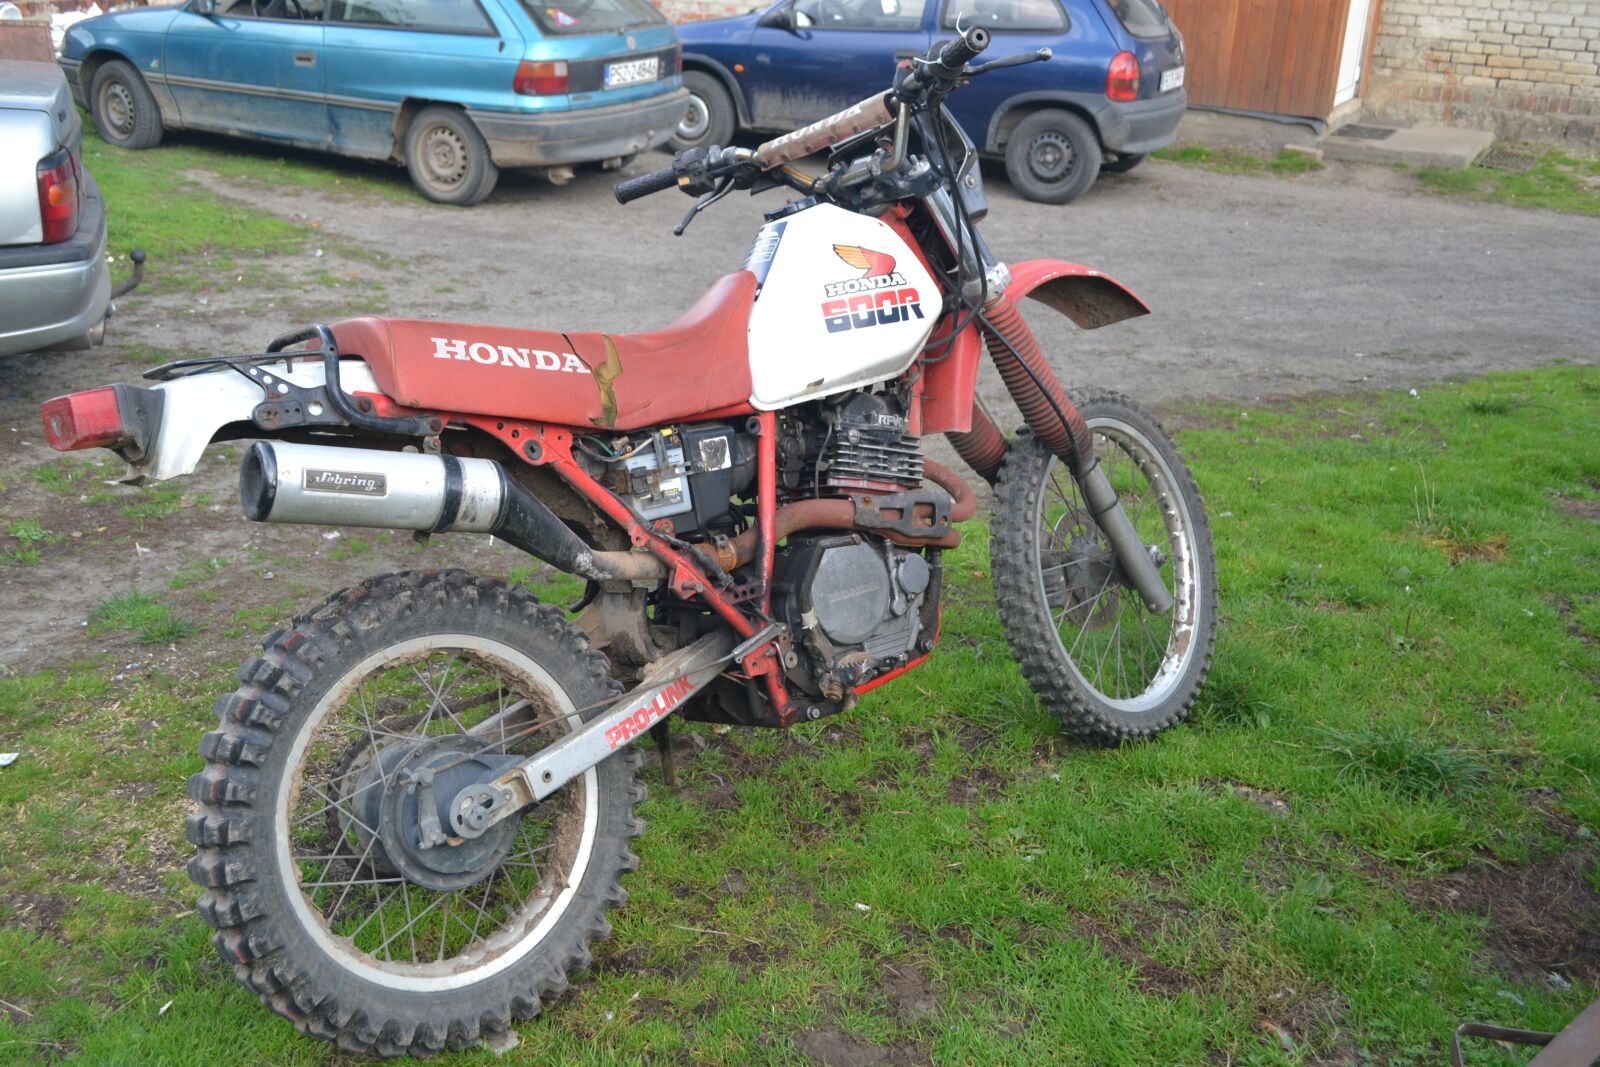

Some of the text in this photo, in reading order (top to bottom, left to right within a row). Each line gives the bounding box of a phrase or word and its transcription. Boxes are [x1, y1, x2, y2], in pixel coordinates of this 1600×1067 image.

[824, 272, 907, 298] HONDA
[821, 288, 925, 333] 600R
[431, 337, 592, 374] HONDA
[314, 472, 377, 491] Sebring
[605, 674, 696, 750] PRO-LINK
